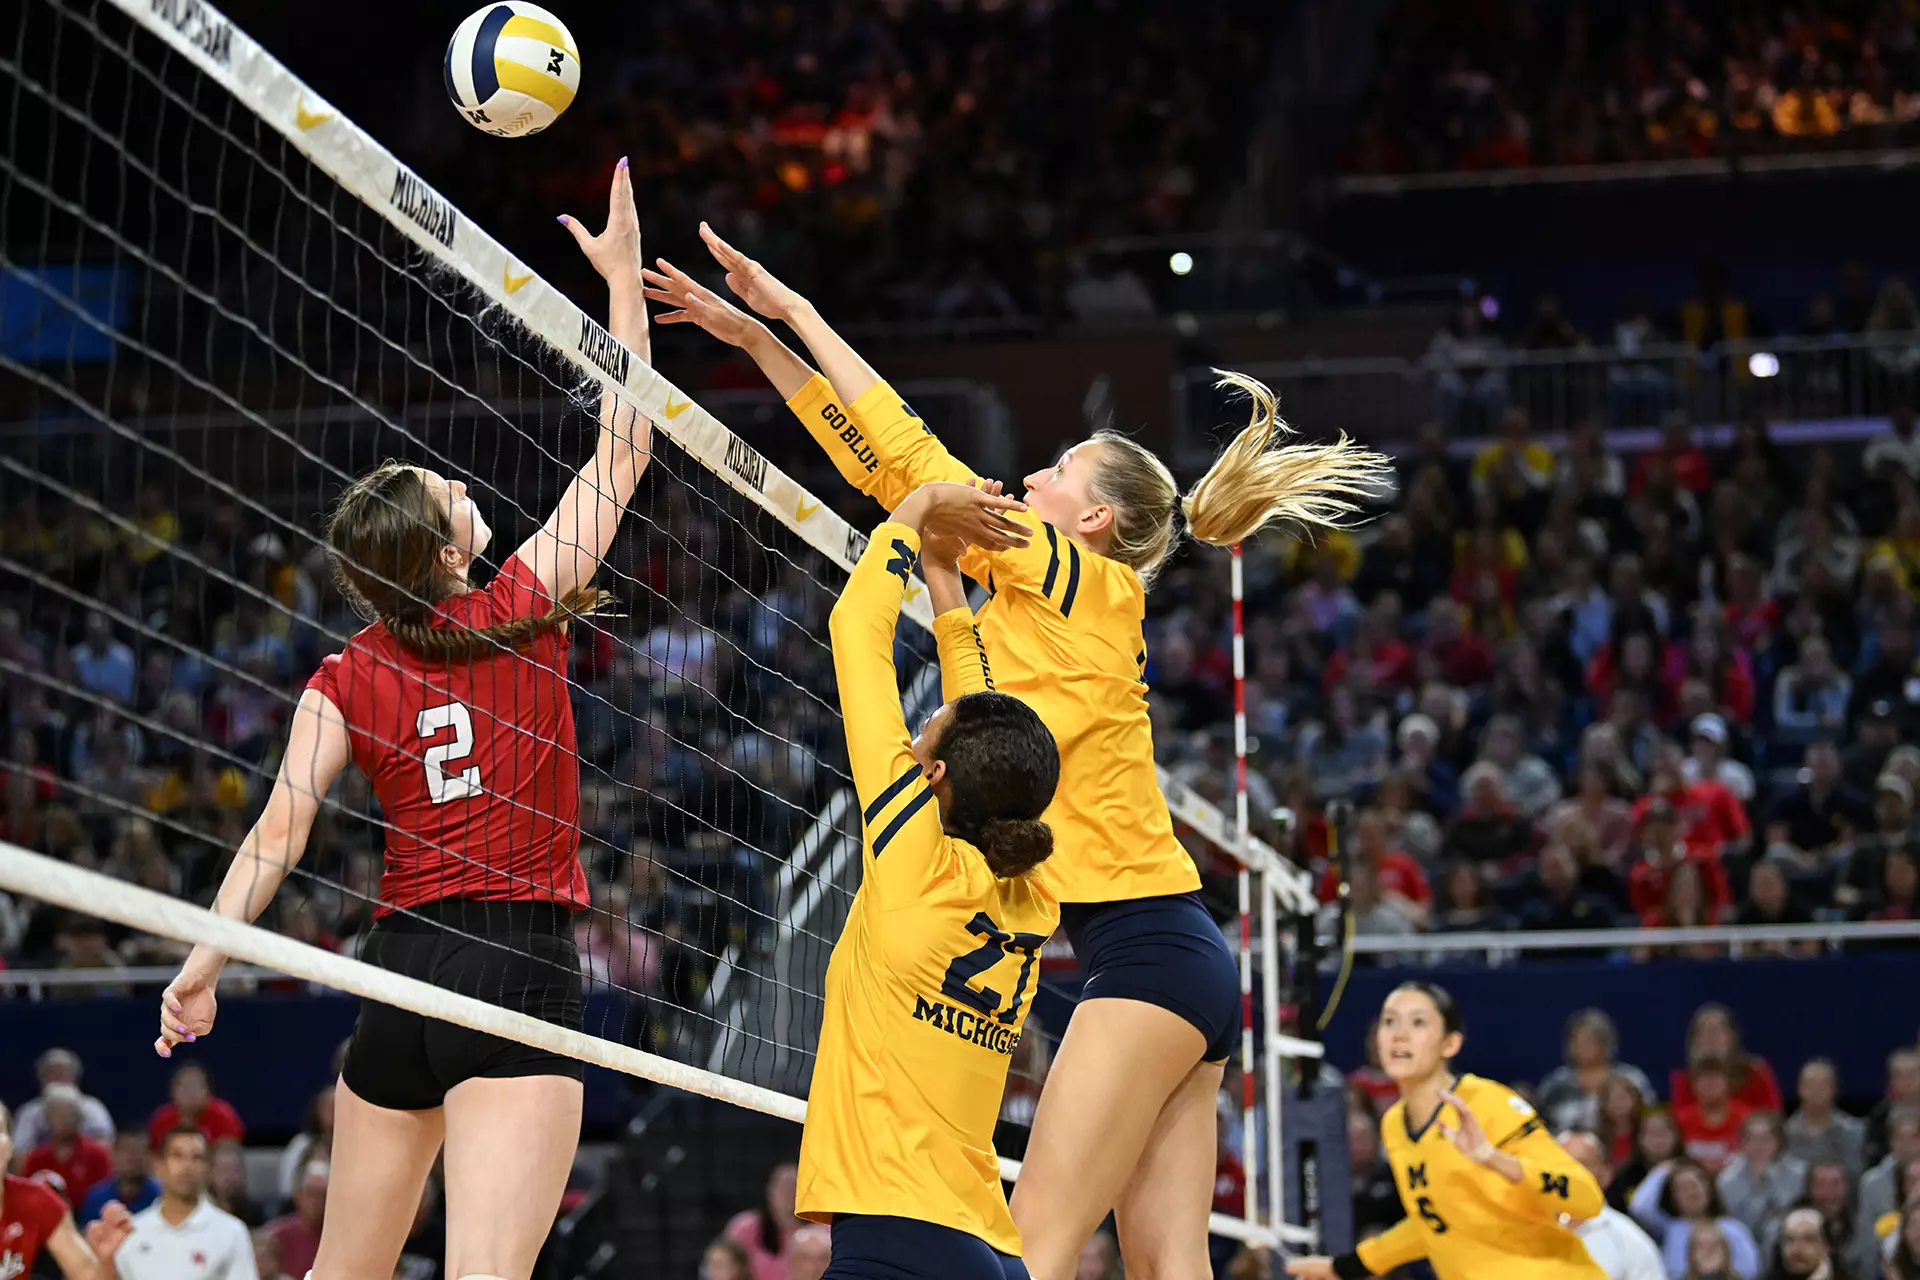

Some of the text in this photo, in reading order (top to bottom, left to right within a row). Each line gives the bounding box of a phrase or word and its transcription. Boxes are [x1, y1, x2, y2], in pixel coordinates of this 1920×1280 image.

[547, 48, 564, 77] M
[467, 109, 492, 124] M
[390, 167, 457, 250] MICHIGAN
[578, 313, 630, 387] MICHIGAN
[724, 432, 768, 494] MICHIGAN
[821, 403, 881, 473] GO BLUE
[415, 701, 484, 804] 2
[1408, 1160, 1428, 1190] M
[1416, 1196, 1448, 1234] 5
